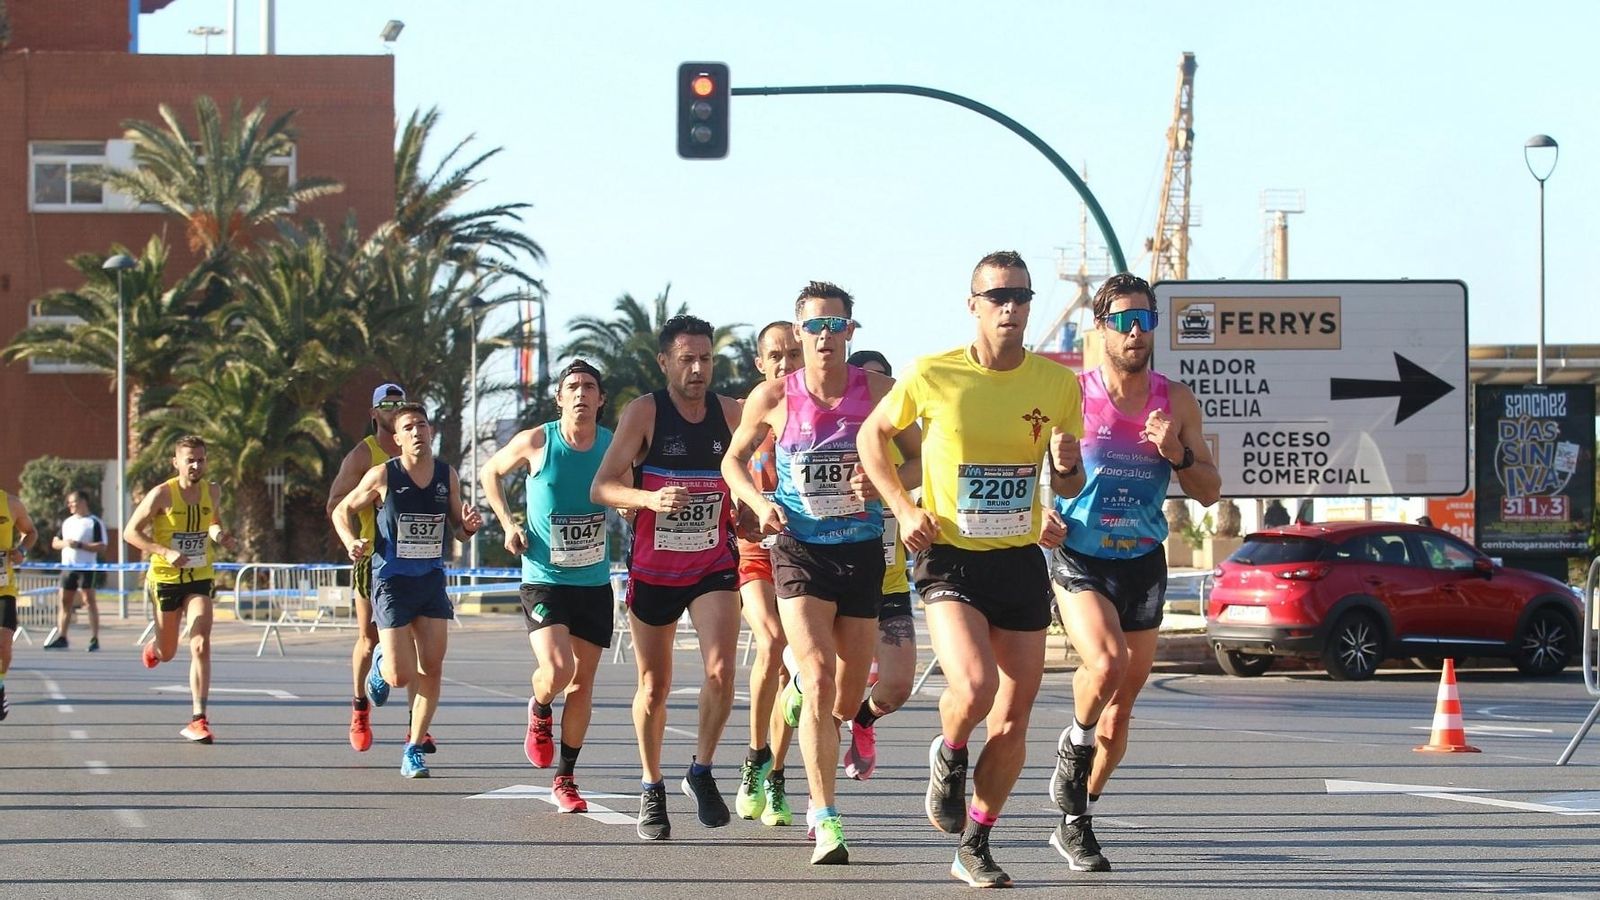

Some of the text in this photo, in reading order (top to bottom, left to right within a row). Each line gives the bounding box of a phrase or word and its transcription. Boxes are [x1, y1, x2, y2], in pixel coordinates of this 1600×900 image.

[1220, 312, 1336, 334] FERRYS
[1180, 359, 1256, 375] NADOR
[1197, 399, 1262, 417] GELIA
[1498, 414, 1559, 441] DÍAS
[1242, 432, 1330, 447] ACCESO
[1243, 452, 1328, 467] PUERTO
[1502, 440, 1554, 467] SIN
[801, 464, 855, 483] 1487
[1242, 469, 1370, 484] COMERCIAL
[969, 479, 1027, 499] 2208
[1103, 496, 1141, 506] PAMPA
[1529, 498, 1537, 514] 1
[1540, 504, 1548, 516] y
[1550, 498, 1563, 514] 3
[410, 523, 437, 535] 637
[560, 524, 601, 540] 1047
[178, 540, 204, 549] 1975
